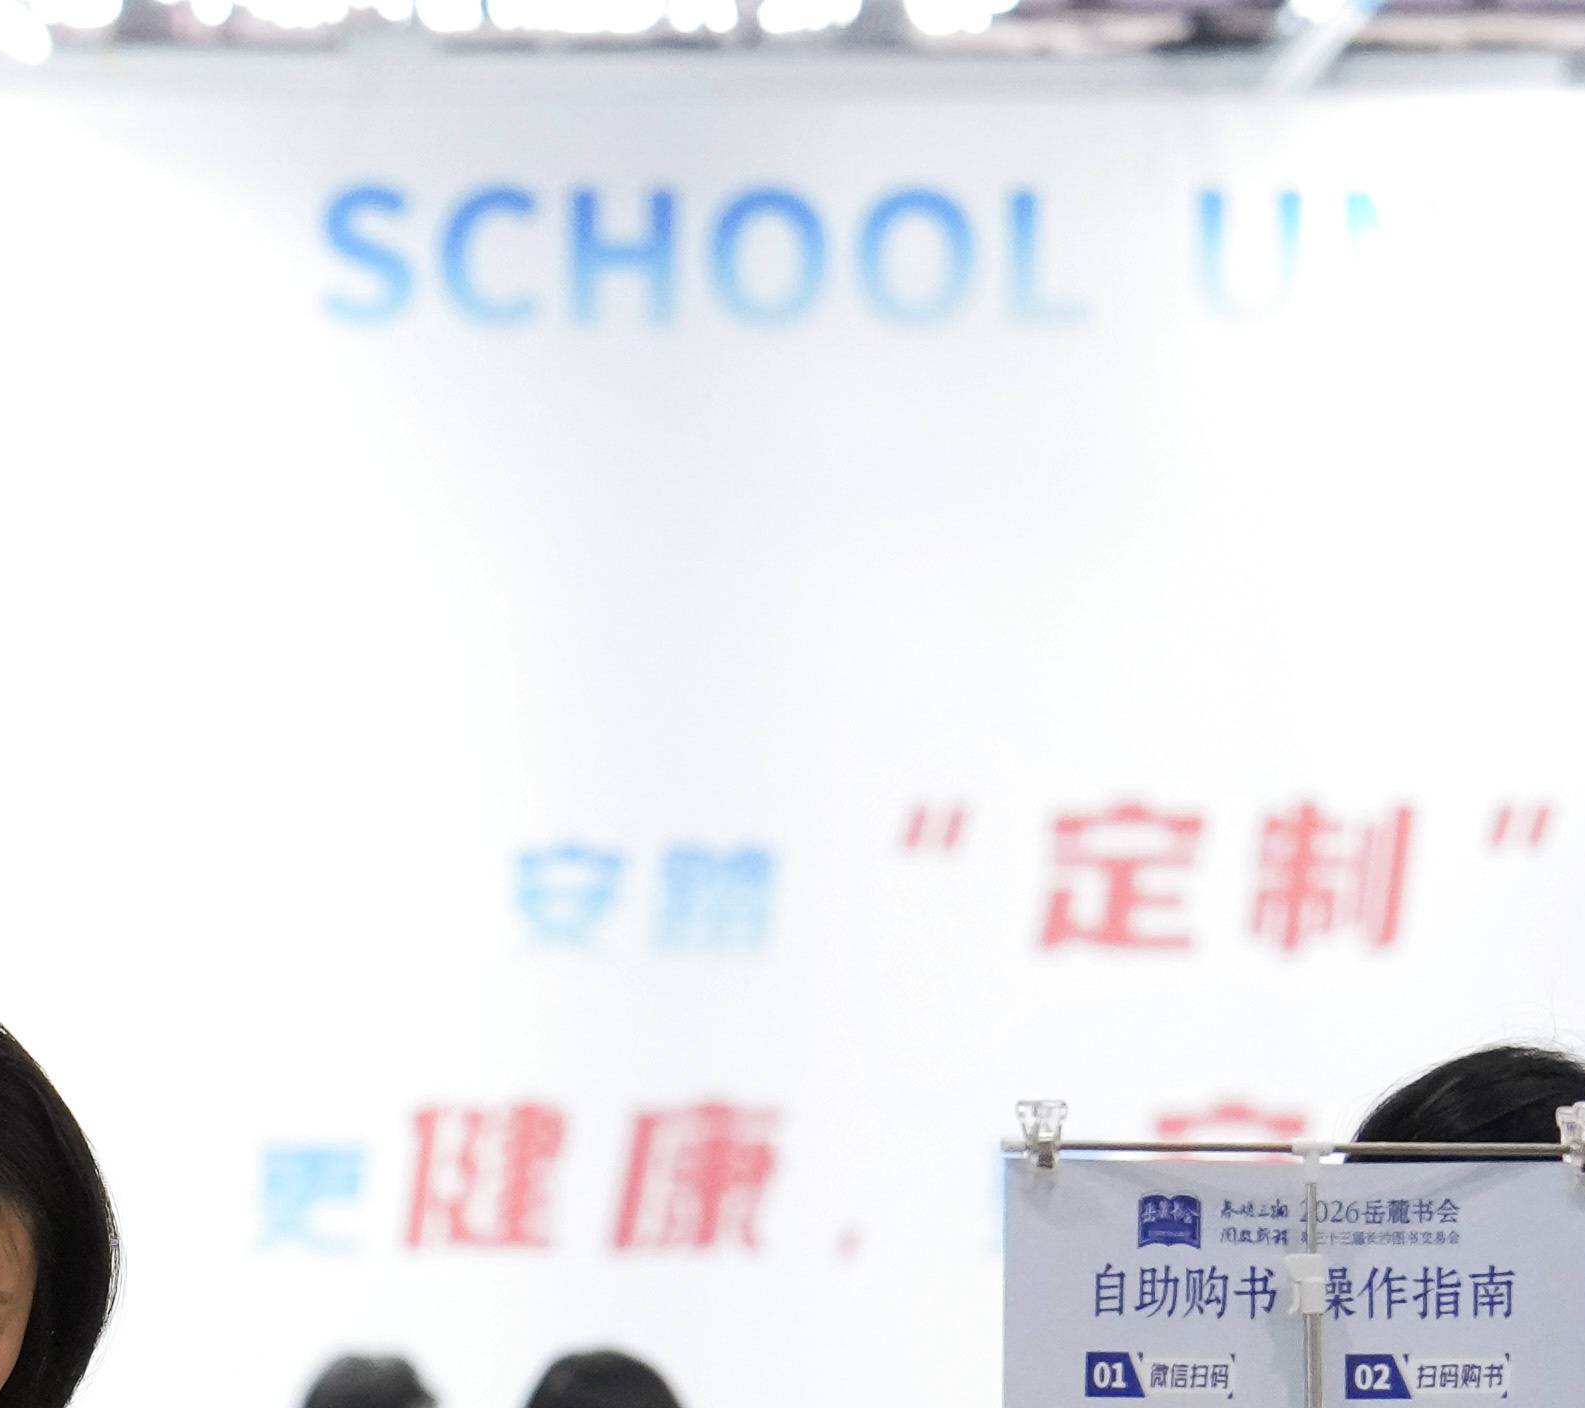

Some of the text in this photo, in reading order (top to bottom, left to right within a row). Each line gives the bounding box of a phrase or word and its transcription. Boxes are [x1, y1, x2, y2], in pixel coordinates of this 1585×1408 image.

[320, 183, 1094, 328] SCHOOL
[1093, 1264, 1516, 1321] 自助购书 操作指南
[1093, 1361, 1127, 1389] 01
[1150, 1363, 1229, 1389] 微信扫码
[1354, 1363, 1392, 1391] 02
[1417, 1363, 1504, 1389] 扫码购书
